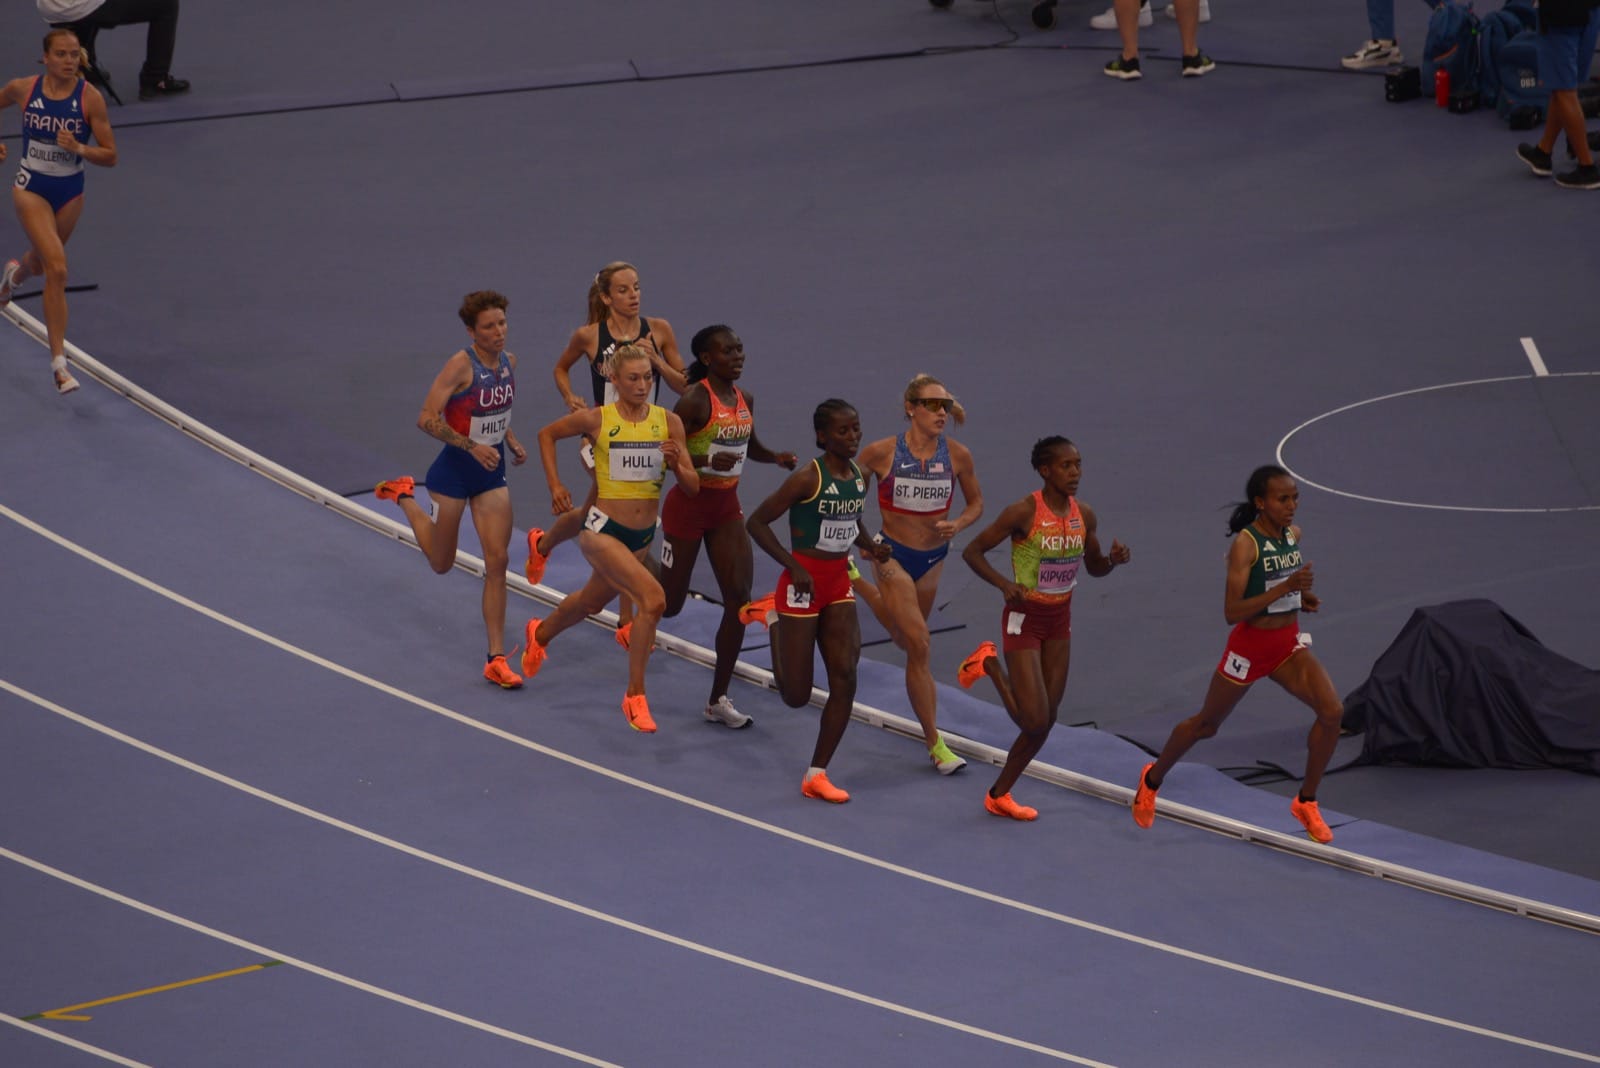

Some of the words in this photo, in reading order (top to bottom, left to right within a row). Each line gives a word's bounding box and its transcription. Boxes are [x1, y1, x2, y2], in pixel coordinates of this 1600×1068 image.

[24, 112, 82, 133] FRANCE
[480, 384, 514, 407] USA
[481, 418, 506, 434] HILTZ
[717, 423, 751, 439] KENYA
[623, 456, 654, 468] HULL
[895, 485, 910, 498] ST.
[913, 487, 950, 499] PIERRE
[818, 498, 866, 514] ETHIOPI
[592, 512, 601, 526] 7
[1041, 535, 1084, 551] KENYA
[663, 546, 671, 562] 11
[794, 590, 803, 603] 2
[1232, 658, 1242, 673] 4
